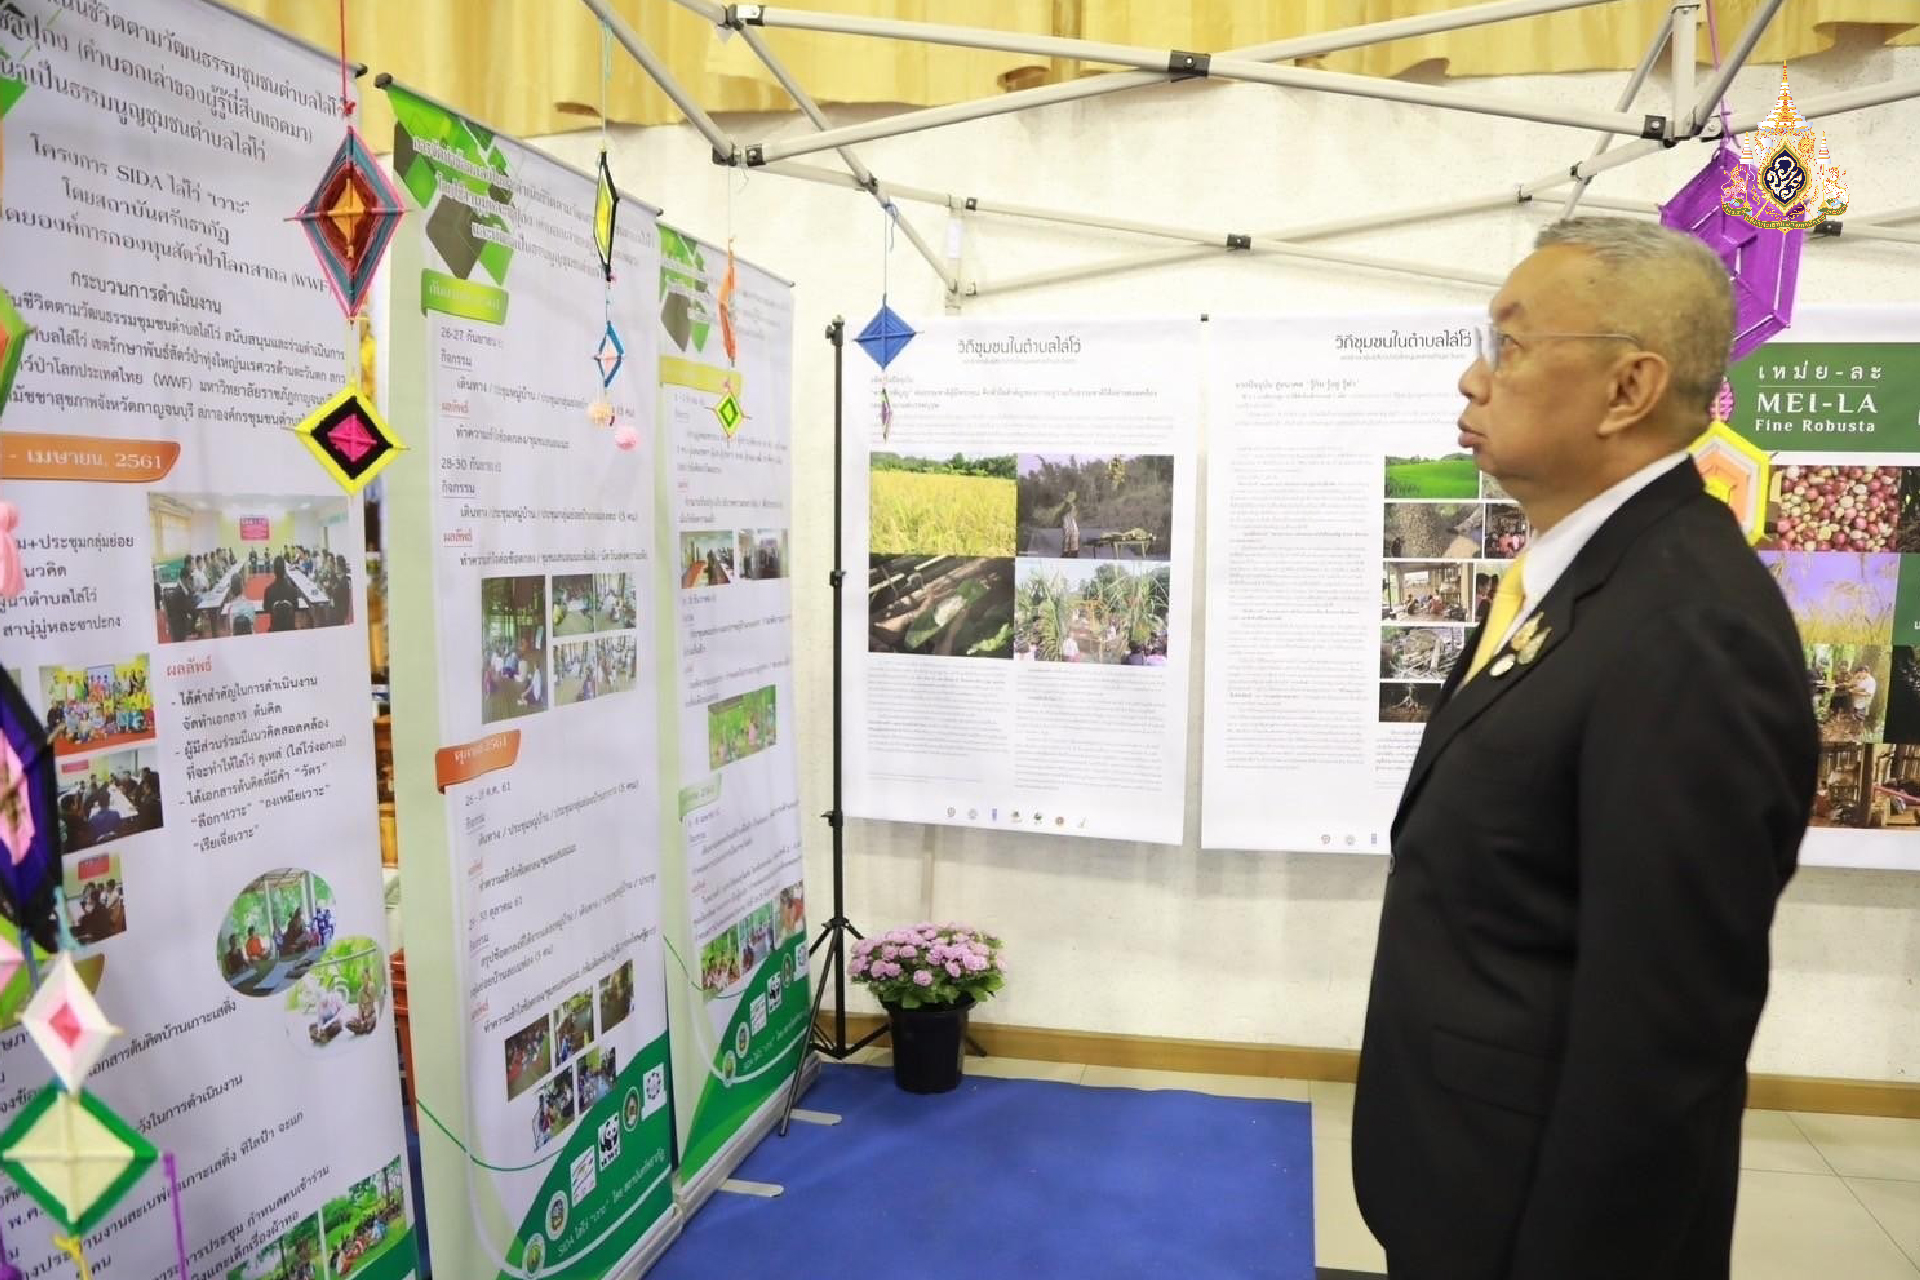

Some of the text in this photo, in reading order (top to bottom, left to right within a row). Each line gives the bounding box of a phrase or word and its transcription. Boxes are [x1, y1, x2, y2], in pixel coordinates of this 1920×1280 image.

[116, 164, 163, 192] SIDA
[71, 271, 222, 315] กระบวนการดำเนินงาน
[153, 373, 192, 393] (WWF)
[1757, 392, 1878, 414] MEI-LA
[1755, 419, 1875, 432] Fine Robusta
[115, 453, 162, 470] 2561
